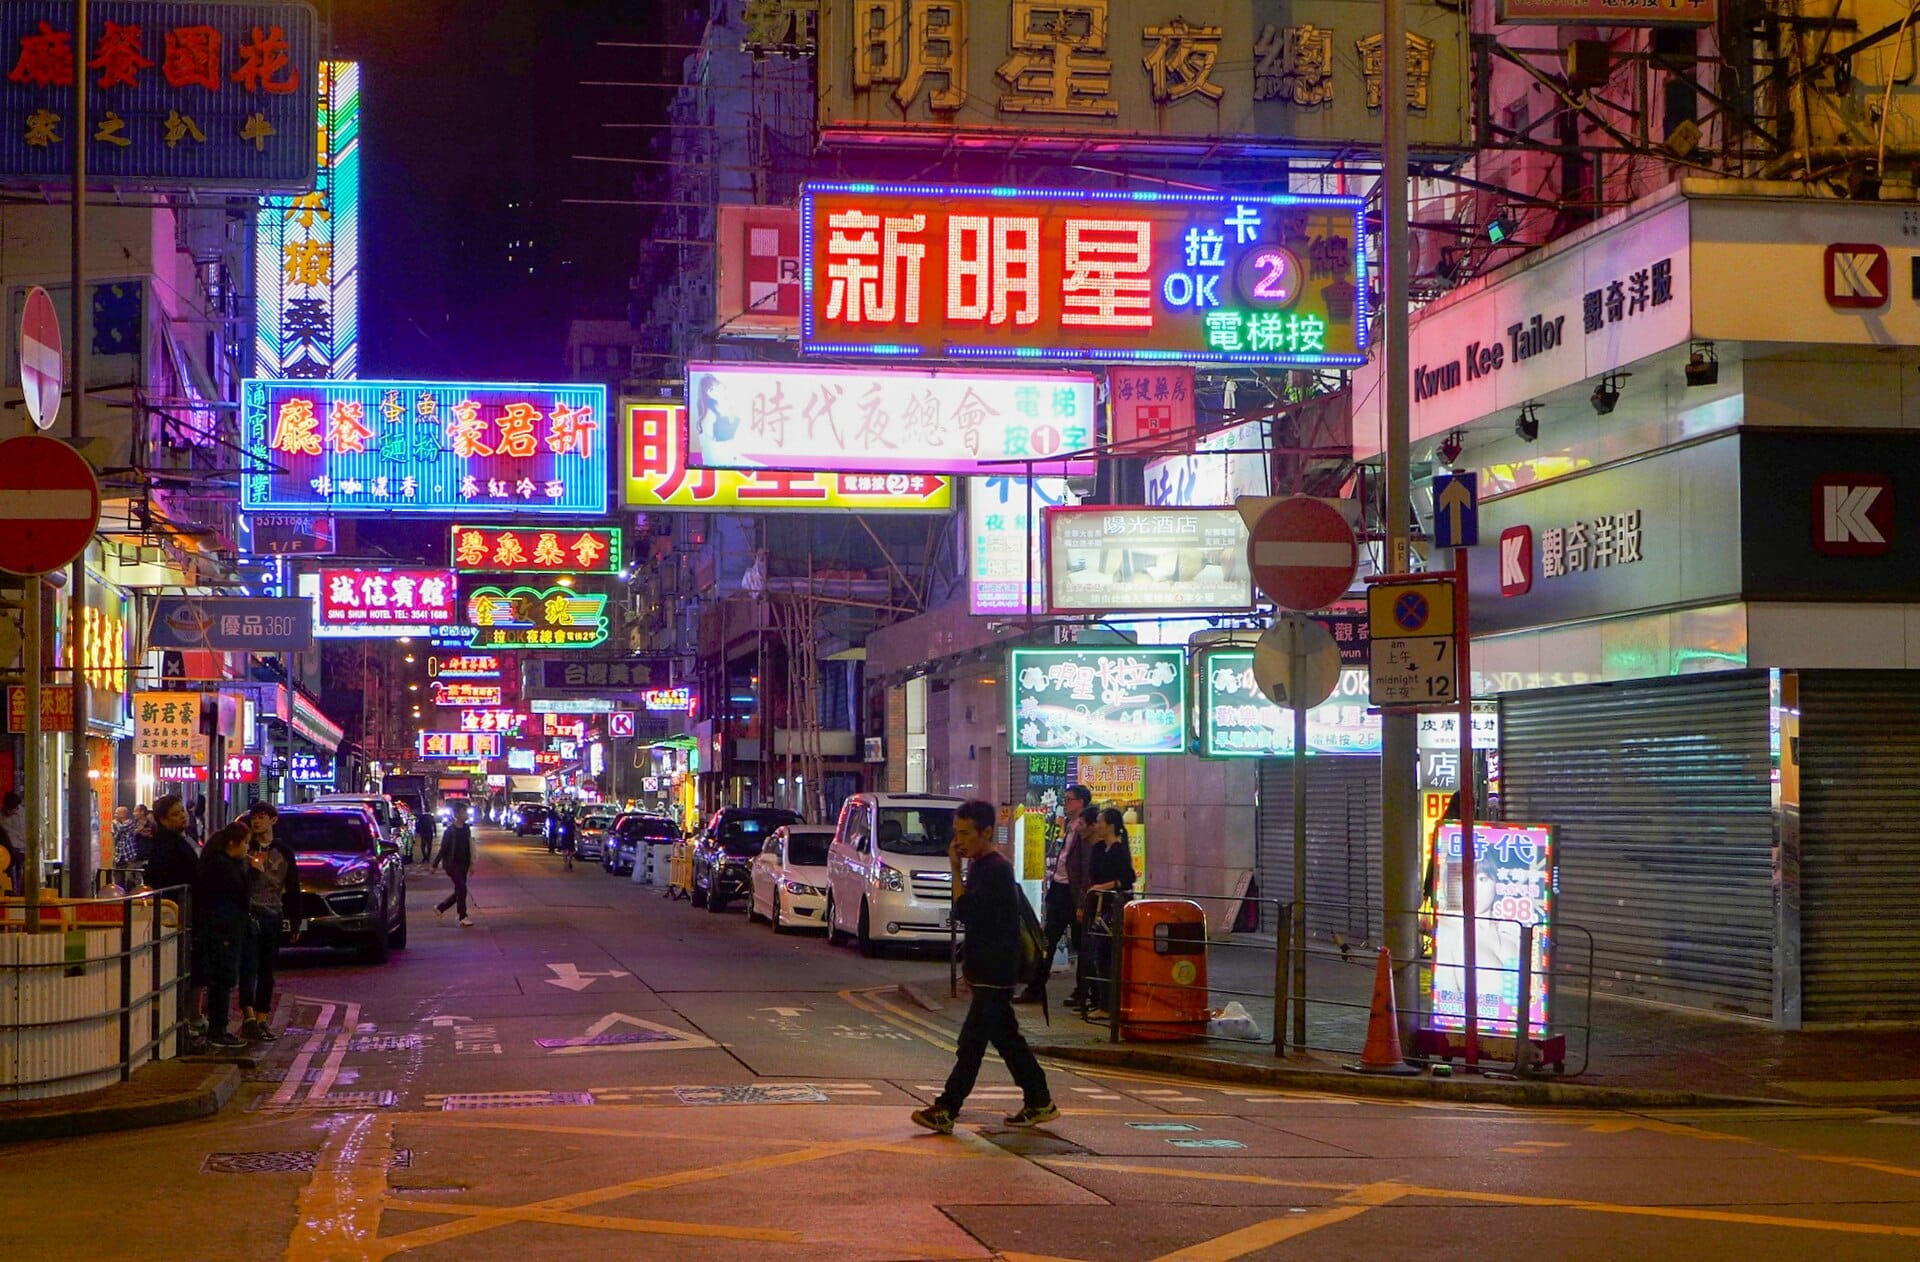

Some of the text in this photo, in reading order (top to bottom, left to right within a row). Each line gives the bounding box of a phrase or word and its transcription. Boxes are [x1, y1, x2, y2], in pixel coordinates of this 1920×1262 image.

[825, 210, 1154, 327] 新明星
[1583, 257, 1674, 335] 觀奇洋服
[1414, 313, 1565, 402] Kwun Kee Tailor
[1102, 514, 1198, 536] 陽光酒店
[1541, 508, 1642, 579] 觀奇洋服
[369, 610, 392, 619] HOTEL
[1339, 648, 1361, 658] wun
[1391, 641, 1406, 649] am
[1433, 641, 1447, 662] 7
[1386, 651, 1412, 664] 上午
[1376, 674, 1419, 685] midnight
[1426, 675, 1450, 697] 12
[141, 701, 194, 724] 新君豪
[1427, 751, 1458, 777] 店
[1090, 782, 1135, 792] Sun Hotel
[1430, 777, 1456, 788] 4/F
